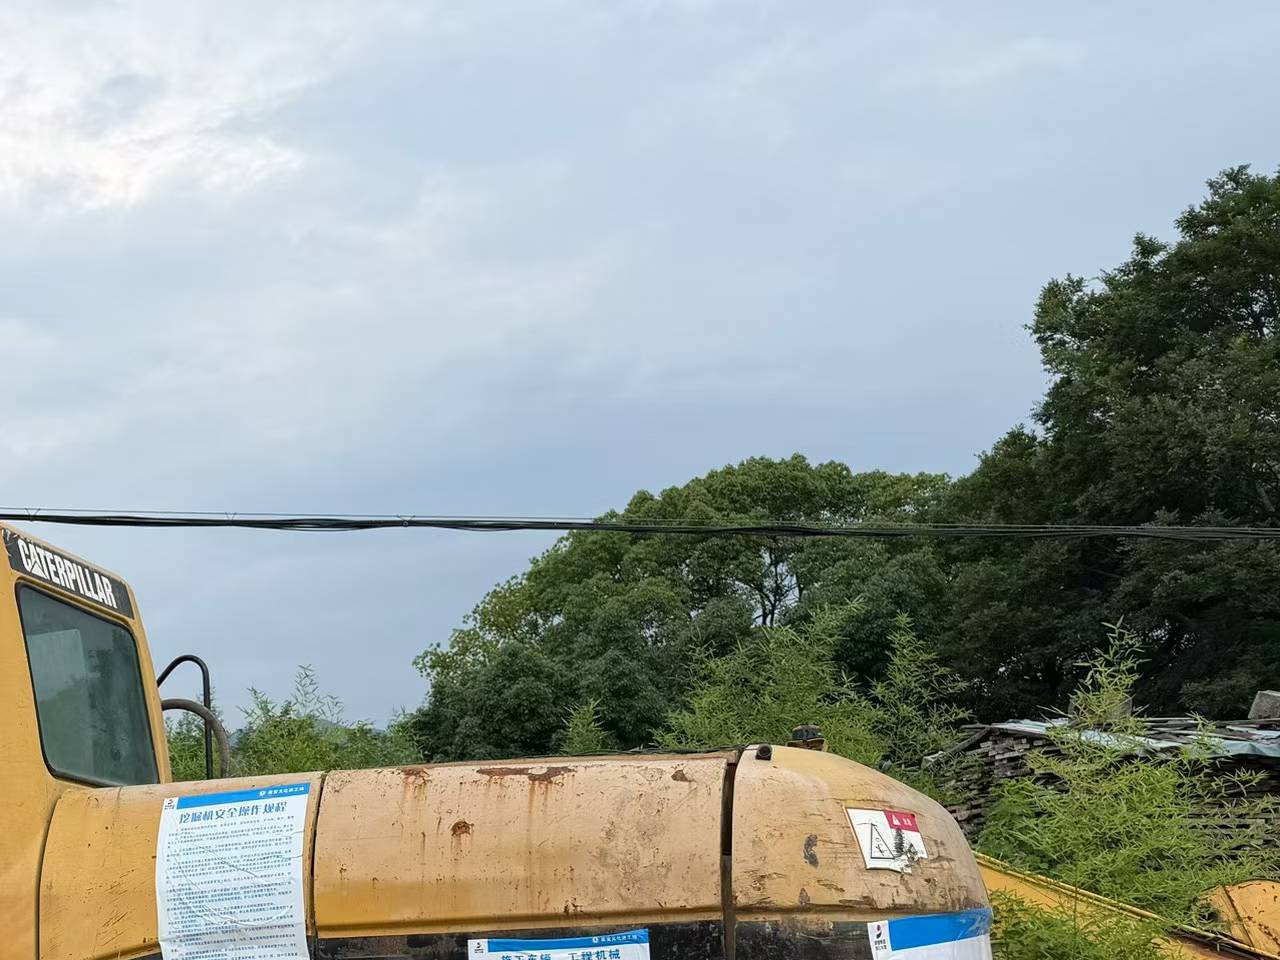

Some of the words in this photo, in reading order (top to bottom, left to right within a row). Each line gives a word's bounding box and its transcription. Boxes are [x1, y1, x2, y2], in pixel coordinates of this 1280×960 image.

[17, 538, 118, 609] CATERPILLAR
[179, 801, 287, 825] 挖掘机安全操作规程
